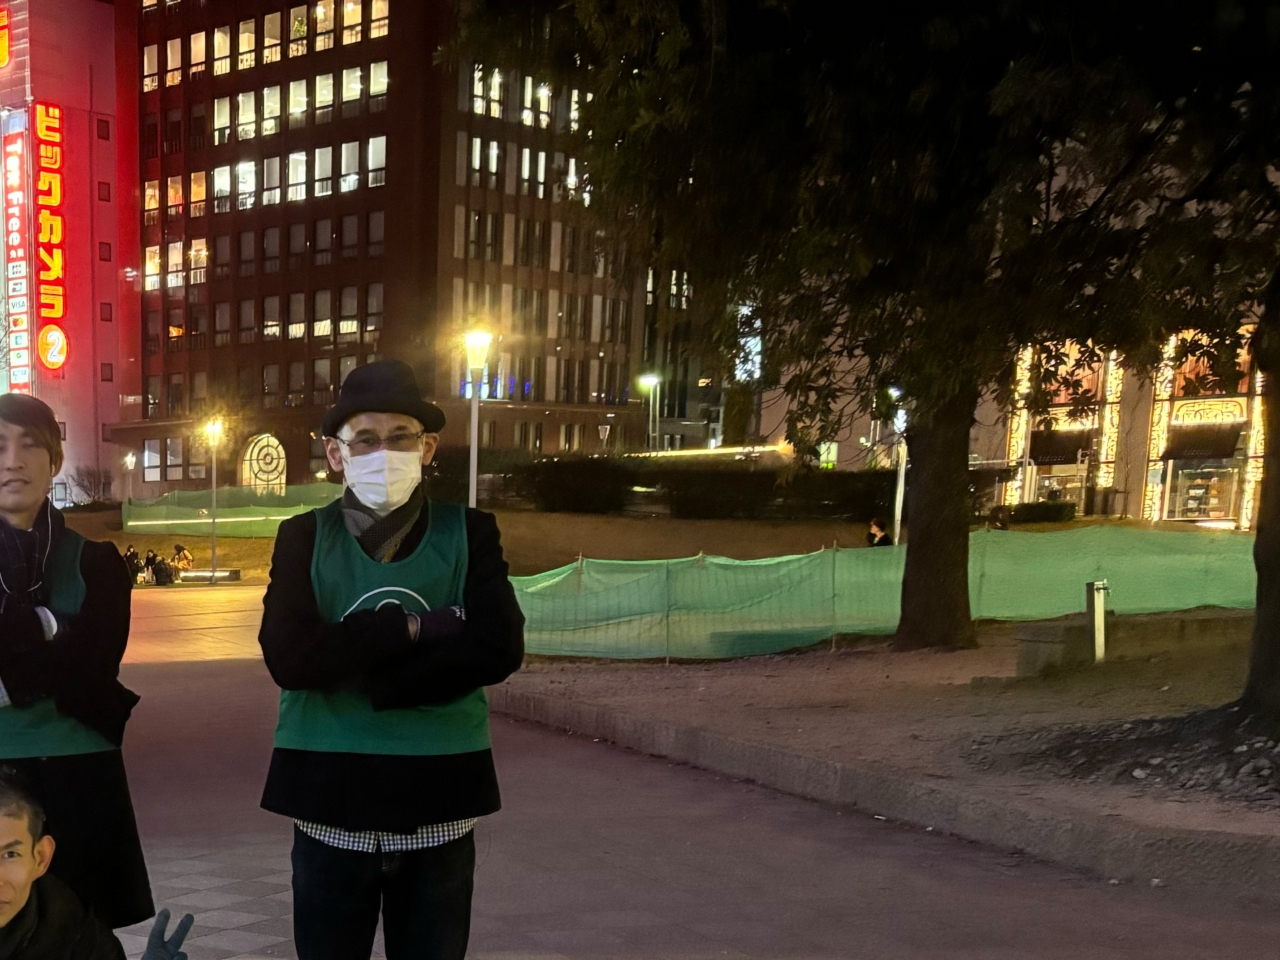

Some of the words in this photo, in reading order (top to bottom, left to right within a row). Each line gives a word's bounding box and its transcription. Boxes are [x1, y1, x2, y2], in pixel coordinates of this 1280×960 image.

[6, 138, 22, 188] Tax
[8, 191, 23, 246] Free
[35, 104, 63, 318] ビックカメラ
[11, 300, 26, 309] VISA
[47, 330, 63, 362] 2
